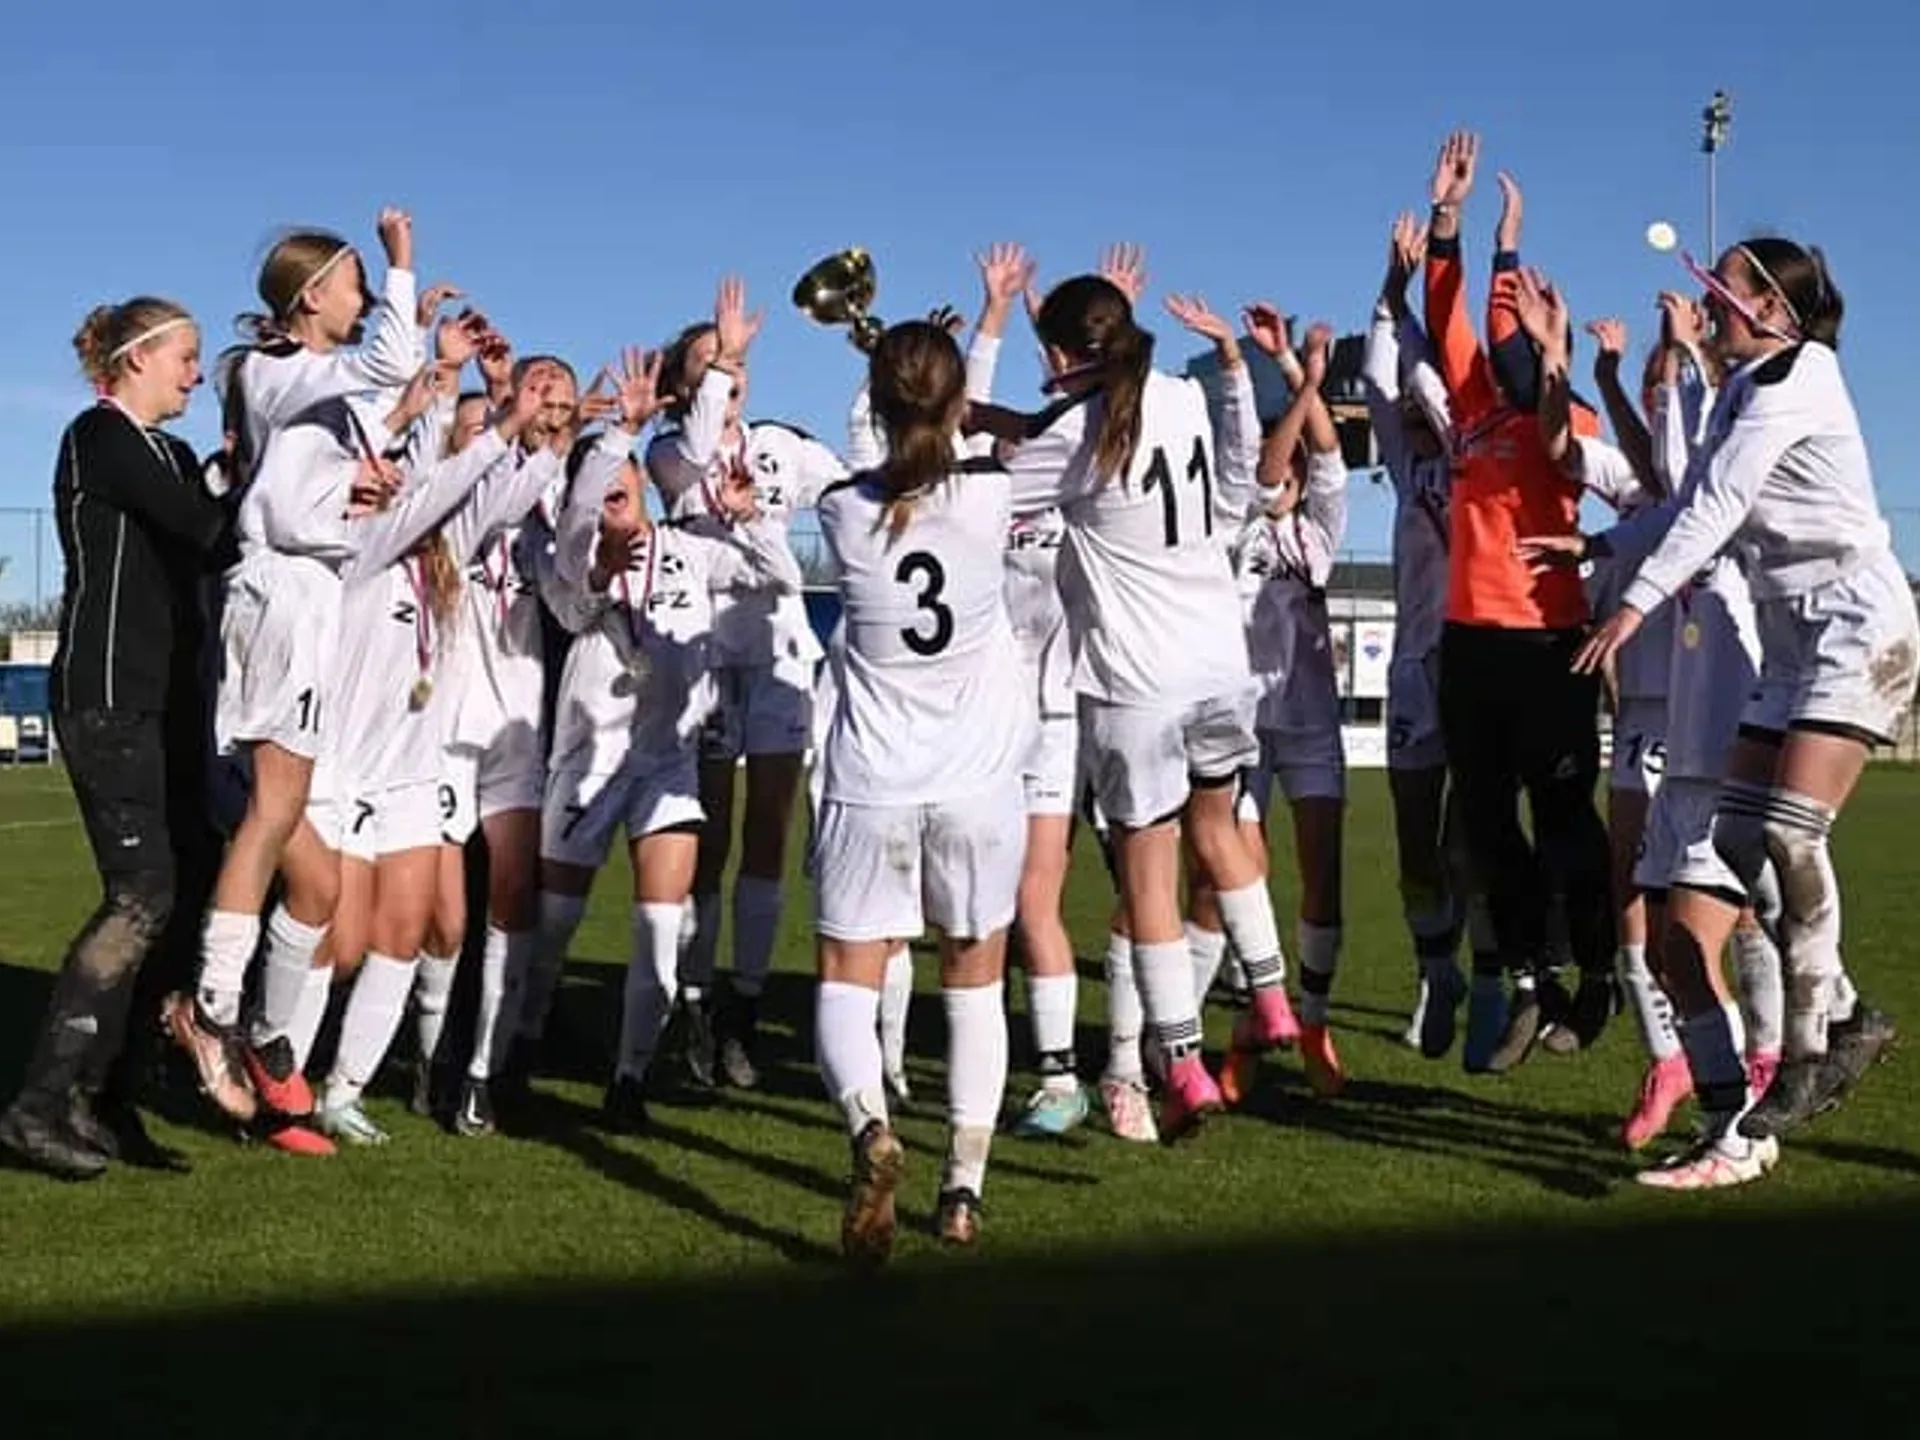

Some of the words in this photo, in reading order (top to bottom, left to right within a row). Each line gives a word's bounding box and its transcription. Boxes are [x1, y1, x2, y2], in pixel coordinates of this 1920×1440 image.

[1141, 434, 1212, 547] 11
[895, 551, 954, 656] 3
[1626, 733, 1668, 775] 15
[352, 798, 375, 834] 7
[562, 804, 587, 841] 7
